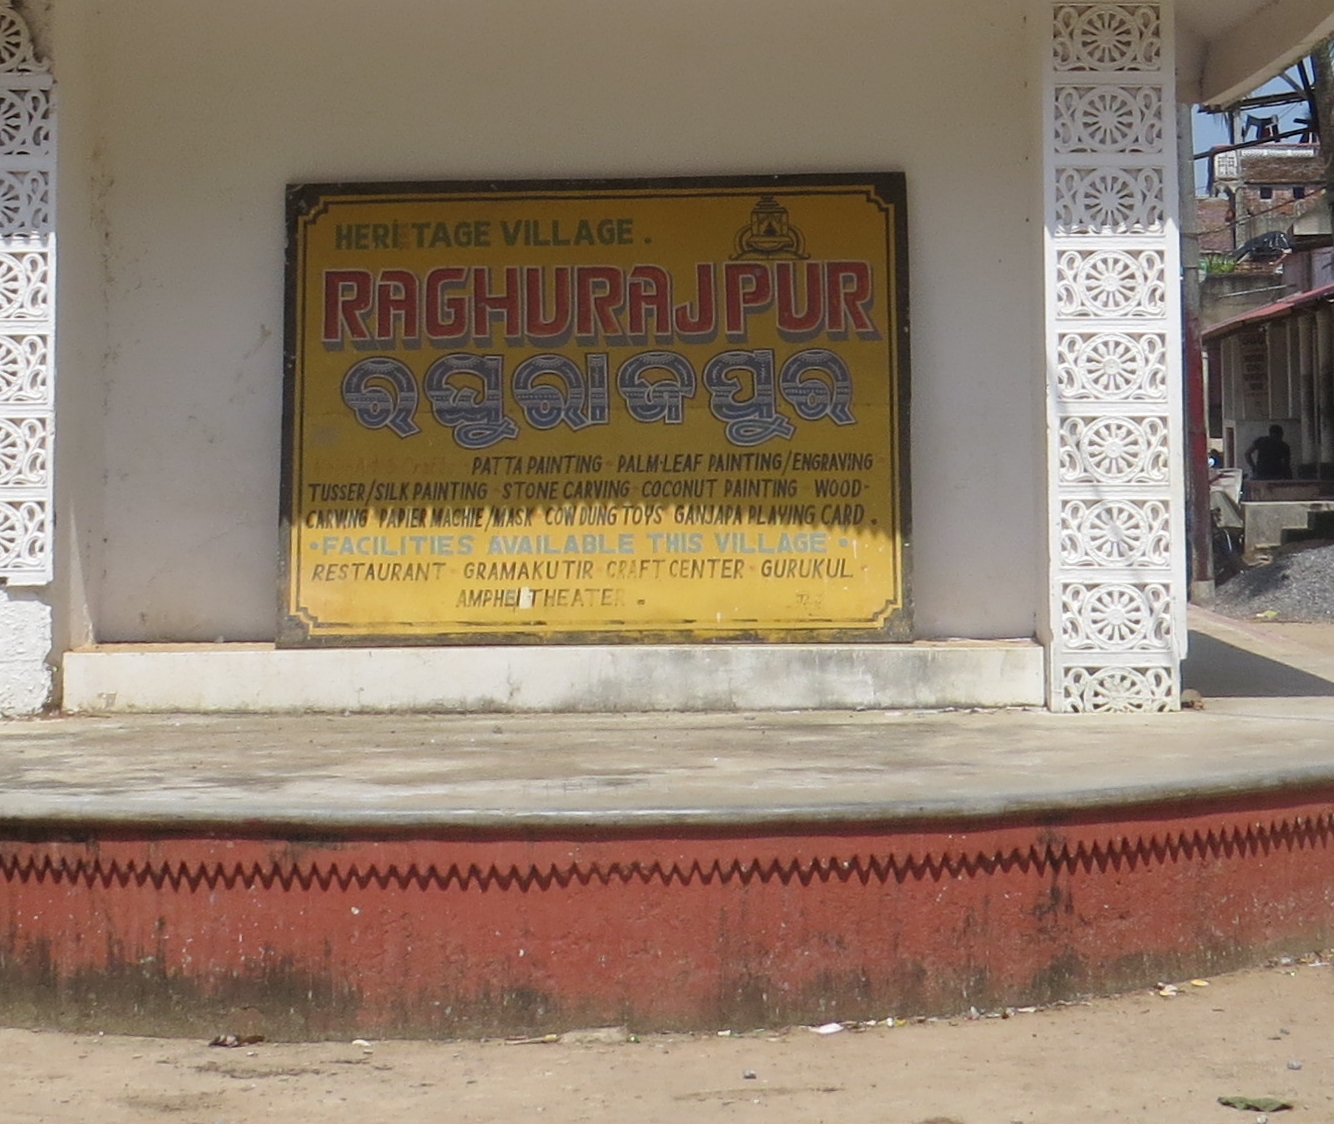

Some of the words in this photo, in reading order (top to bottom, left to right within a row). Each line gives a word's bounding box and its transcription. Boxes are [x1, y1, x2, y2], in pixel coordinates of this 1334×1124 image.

[335, 221, 490, 250] HERITAGE
[499, 218, 633, 246] VILLAGE
[321, 260, 883, 352] RAGHURAJPUR
[472, 456, 522, 476] PATTA
[527, 454, 603, 474] PAINTING
[708, 450, 874, 476] PAINTING/ENGRAVING
[308, 479, 410, 506] TUSSER/SILK
[413, 482, 487, 500] PAINTING
[502, 480, 559, 500] STONE
[563, 480, 630, 500] CARVING
[641, 479, 718, 499] COCONUT
[723, 478, 798, 498] PAINTING
[306, 508, 368, 529] CARVING
[378, 508, 427, 528] PAPIER
[544, 506, 575, 526] COW
[579, 505, 618, 525] DUNG
[623, 505, 663, 525] TOYS
[674, 506, 743, 525] GANJAPA
[748, 505, 816, 525] PLAYING
[821, 504, 865, 525] CARD
[321, 535, 475, 556] FACILITIES
[487, 534, 635, 555] AVAILABLE
[646, 533, 704, 553] THIS
[716, 532, 828, 553] VILLAGE
[311, 562, 446, 581] RESTAURANT
[606, 559, 665, 578] CRAFT
[670, 559, 745, 579] CENTER
[761, 558, 855, 579] GURUKUL
